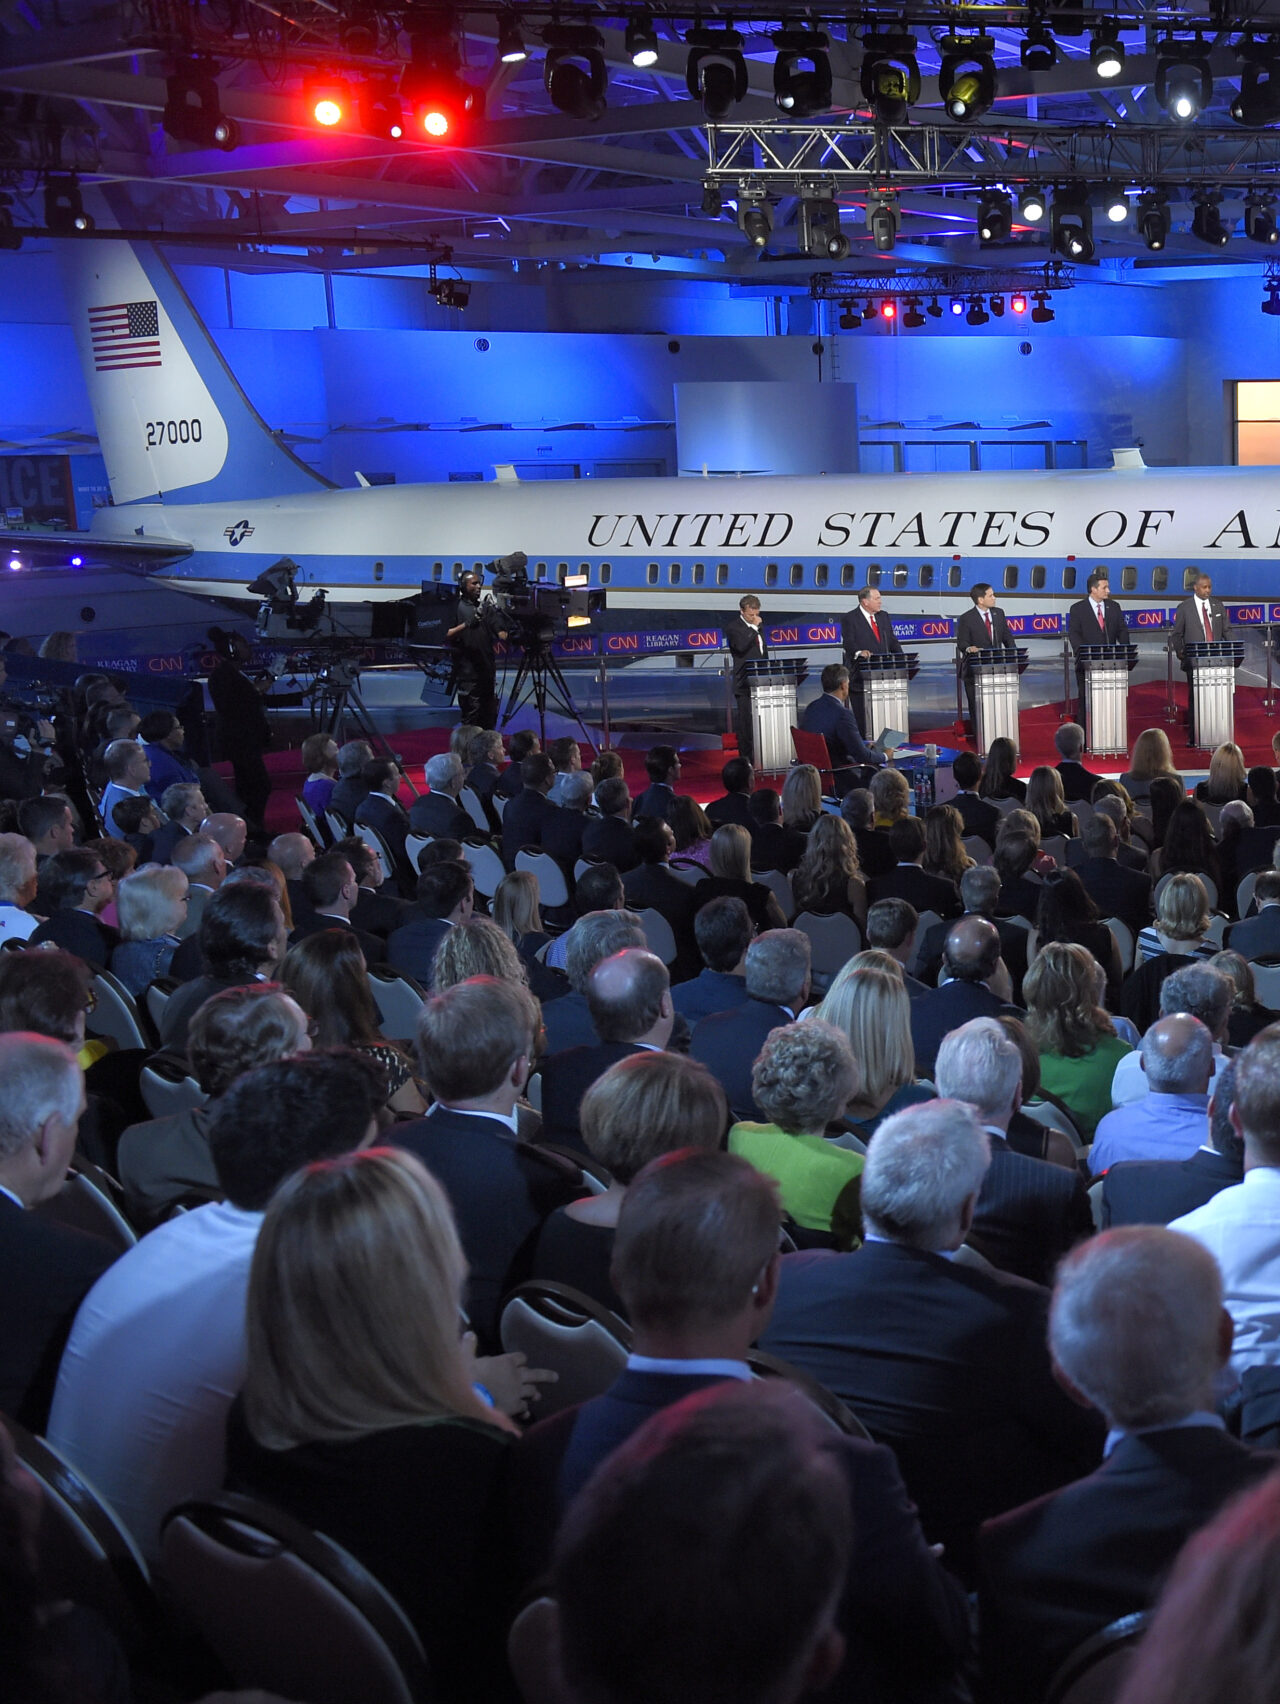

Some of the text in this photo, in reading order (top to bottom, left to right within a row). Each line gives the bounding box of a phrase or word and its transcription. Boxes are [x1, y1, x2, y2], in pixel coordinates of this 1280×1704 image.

[146, 418, 202, 446] 27000
[586, 513, 794, 548] UNITED
[817, 511, 1055, 548] STATES
[1085, 508, 1175, 548] OF
[1137, 611, 1162, 625] CNN
[1237, 607, 1261, 620] CNN
[922, 621, 949, 635] CNN
[1006, 617, 1025, 632] NN
[1033, 616, 1058, 631] CNN
[646, 634, 680, 642] REAGAN
[688, 631, 717, 646] CNN
[770, 628, 798, 642] CNN
[808, 626, 836, 640] CNN
[562, 638, 592, 651] CNN
[608, 634, 638, 649] CNN
[646, 640, 680, 648] LIBRARY
[148, 656, 182, 672] CNN
